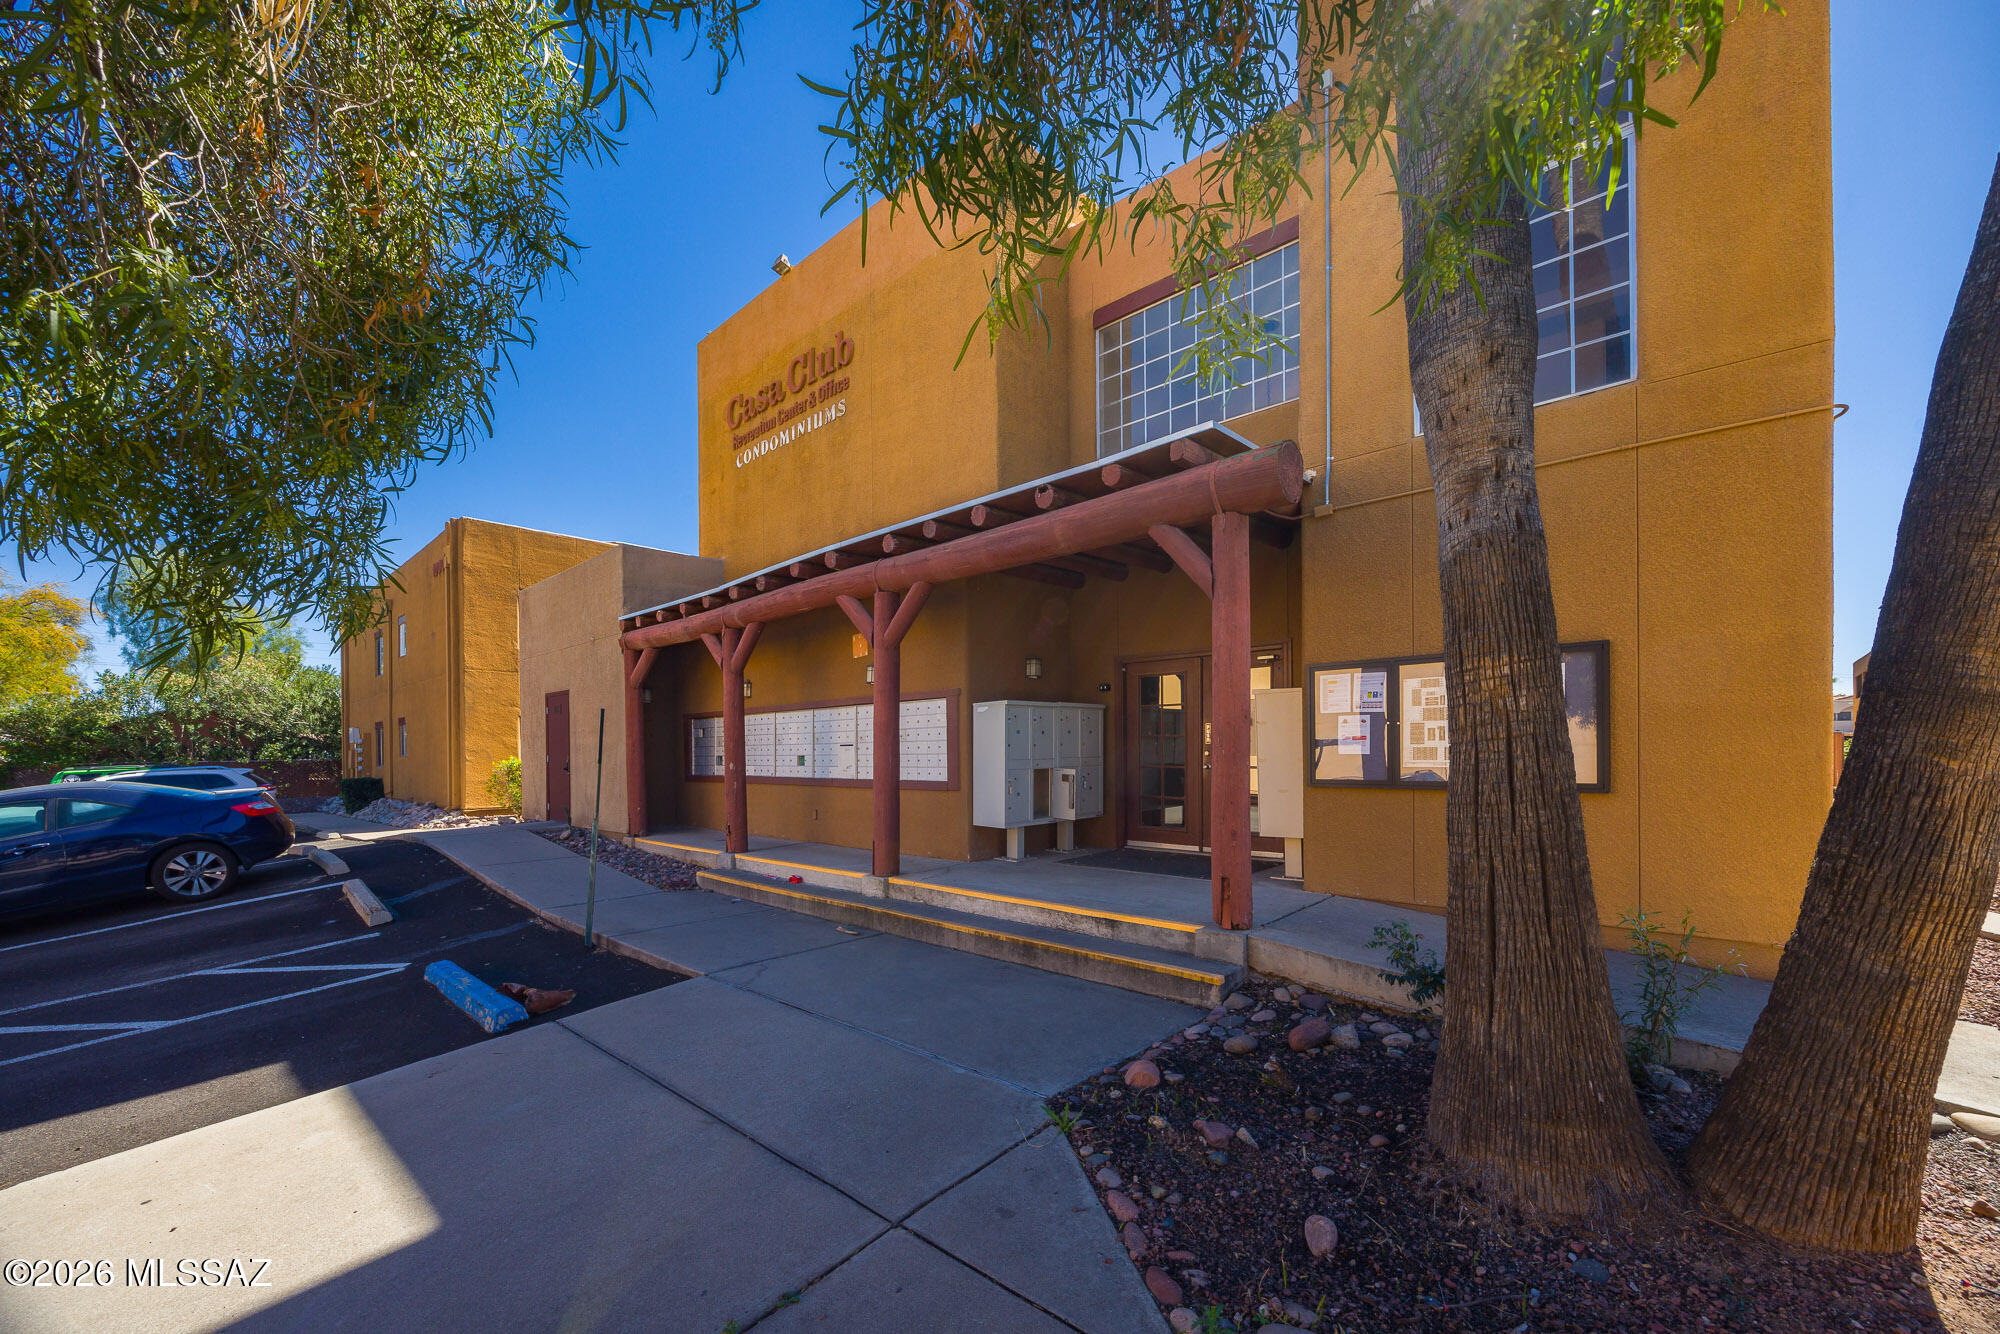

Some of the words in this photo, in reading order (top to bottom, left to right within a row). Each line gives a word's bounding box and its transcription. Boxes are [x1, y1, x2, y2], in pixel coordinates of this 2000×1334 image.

[727, 379, 786, 430] Casa
[788, 330, 855, 393] Club
[733, 417, 776, 450] Recreation
[777, 397, 808, 425] Center
[808, 391, 817, 409] &
[818, 377, 849, 403] Office
[736, 397, 847, 469] CONDOMINIUMS
